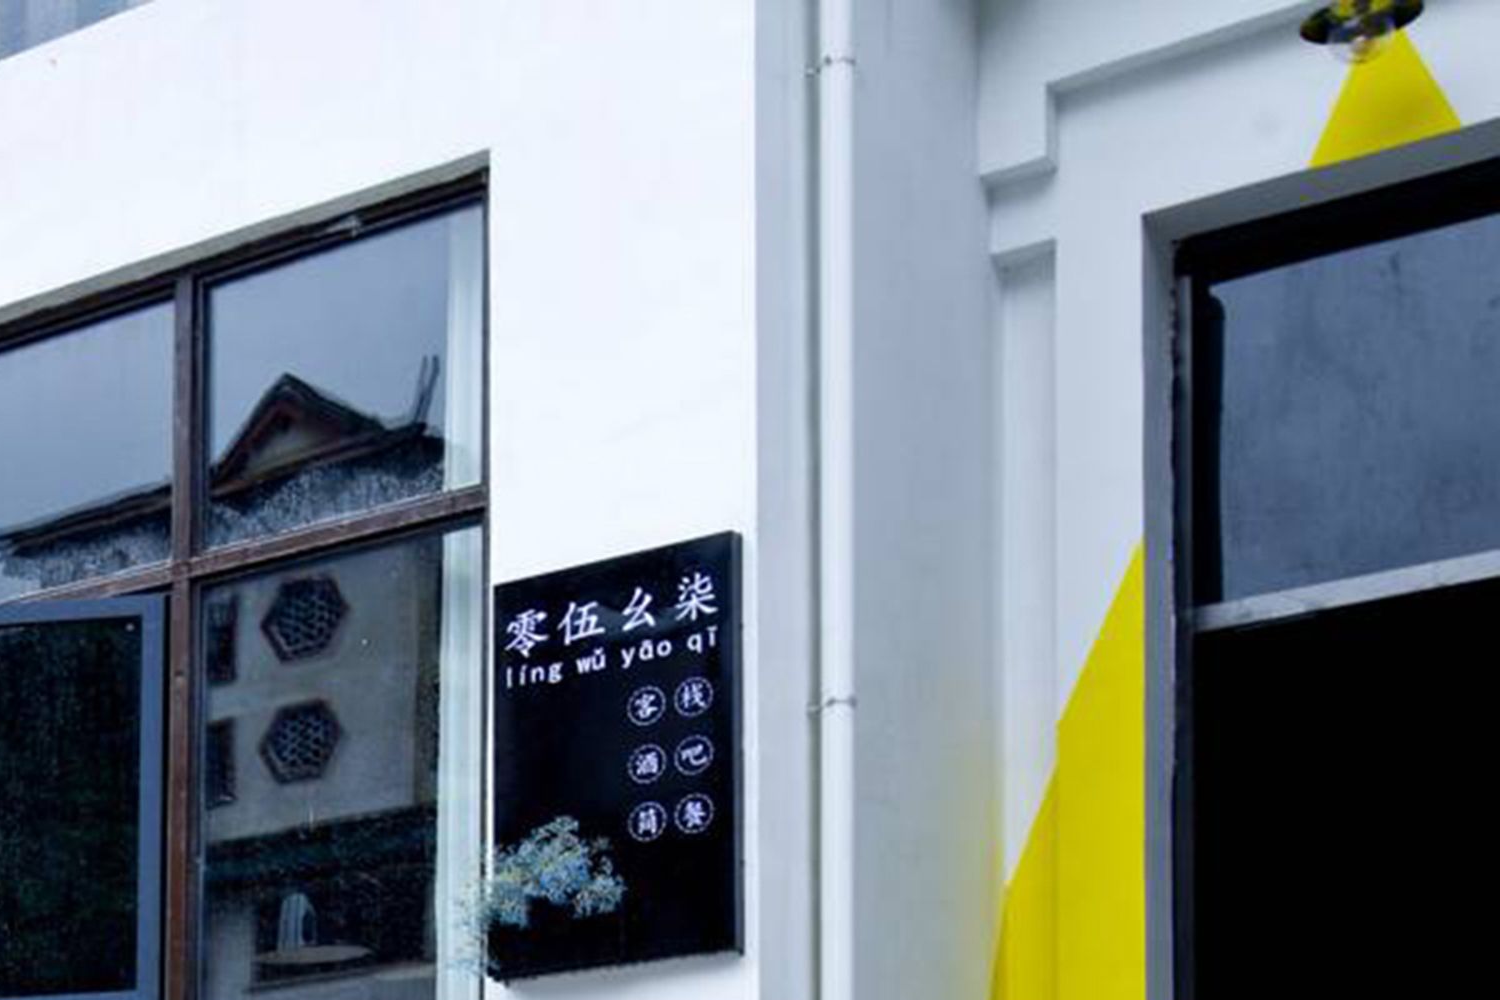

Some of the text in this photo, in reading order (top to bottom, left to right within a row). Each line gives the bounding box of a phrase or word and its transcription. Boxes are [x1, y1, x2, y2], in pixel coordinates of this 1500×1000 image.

[504, 571, 720, 658] 零伍幺柒
[621, 639, 673, 669] yāo
[635, 743, 709, 777] 酒吧
